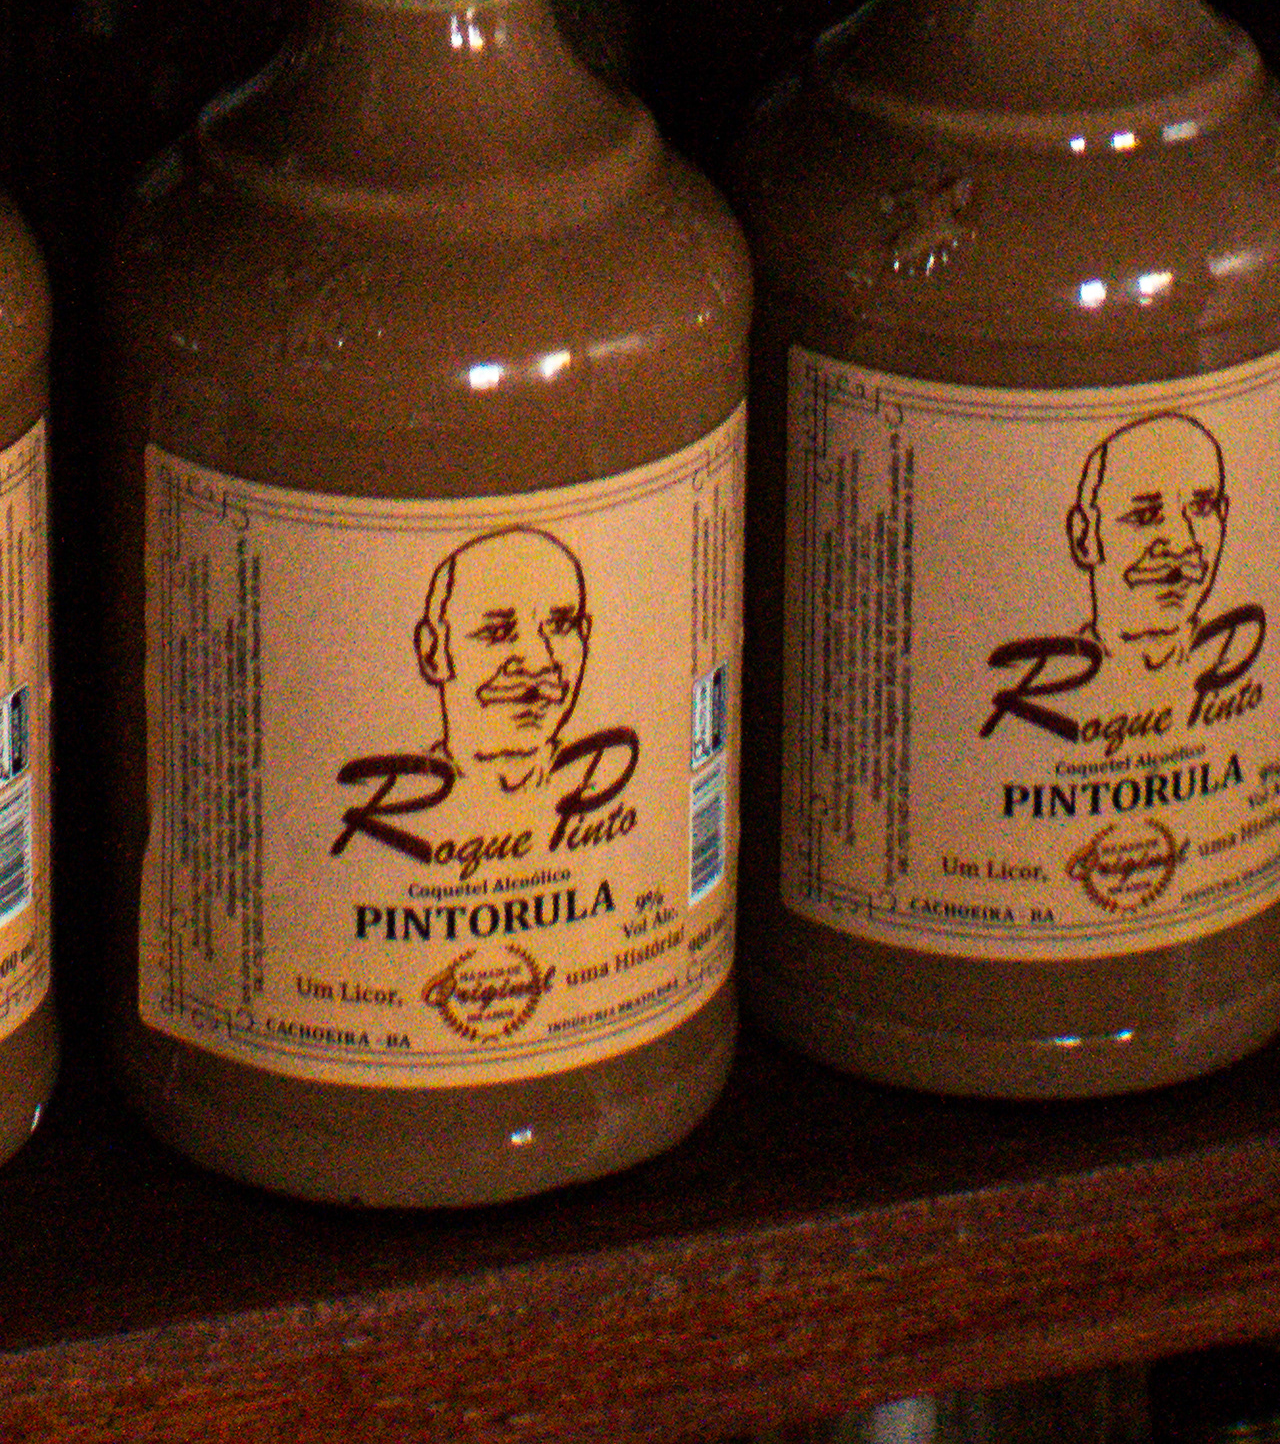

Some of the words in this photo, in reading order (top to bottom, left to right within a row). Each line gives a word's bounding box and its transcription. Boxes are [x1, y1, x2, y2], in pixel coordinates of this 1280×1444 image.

[978, 635, 1174, 759] Roque
[1185, 602, 1267, 729] Pinto
[328, 754, 533, 881] Roque
[548, 726, 641, 853] Pinto
[1002, 751, 1244, 819] PINTORULA
[407, 881, 490, 904] Coquetel
[493, 866, 573, 895] Alcoólico
[942, 854, 982, 879] Um
[987, 857, 1049, 884] Licor,
[354, 879, 615, 942] PINTORULA
[295, 974, 334, 998] Um
[340, 981, 404, 1007] Licor,
[420, 965, 557, 1011] Original
[565, 960, 610, 988] uma
[265, 1019, 370, 1049] CACHOEIRA
[385, 1031, 411, 1050] BA
